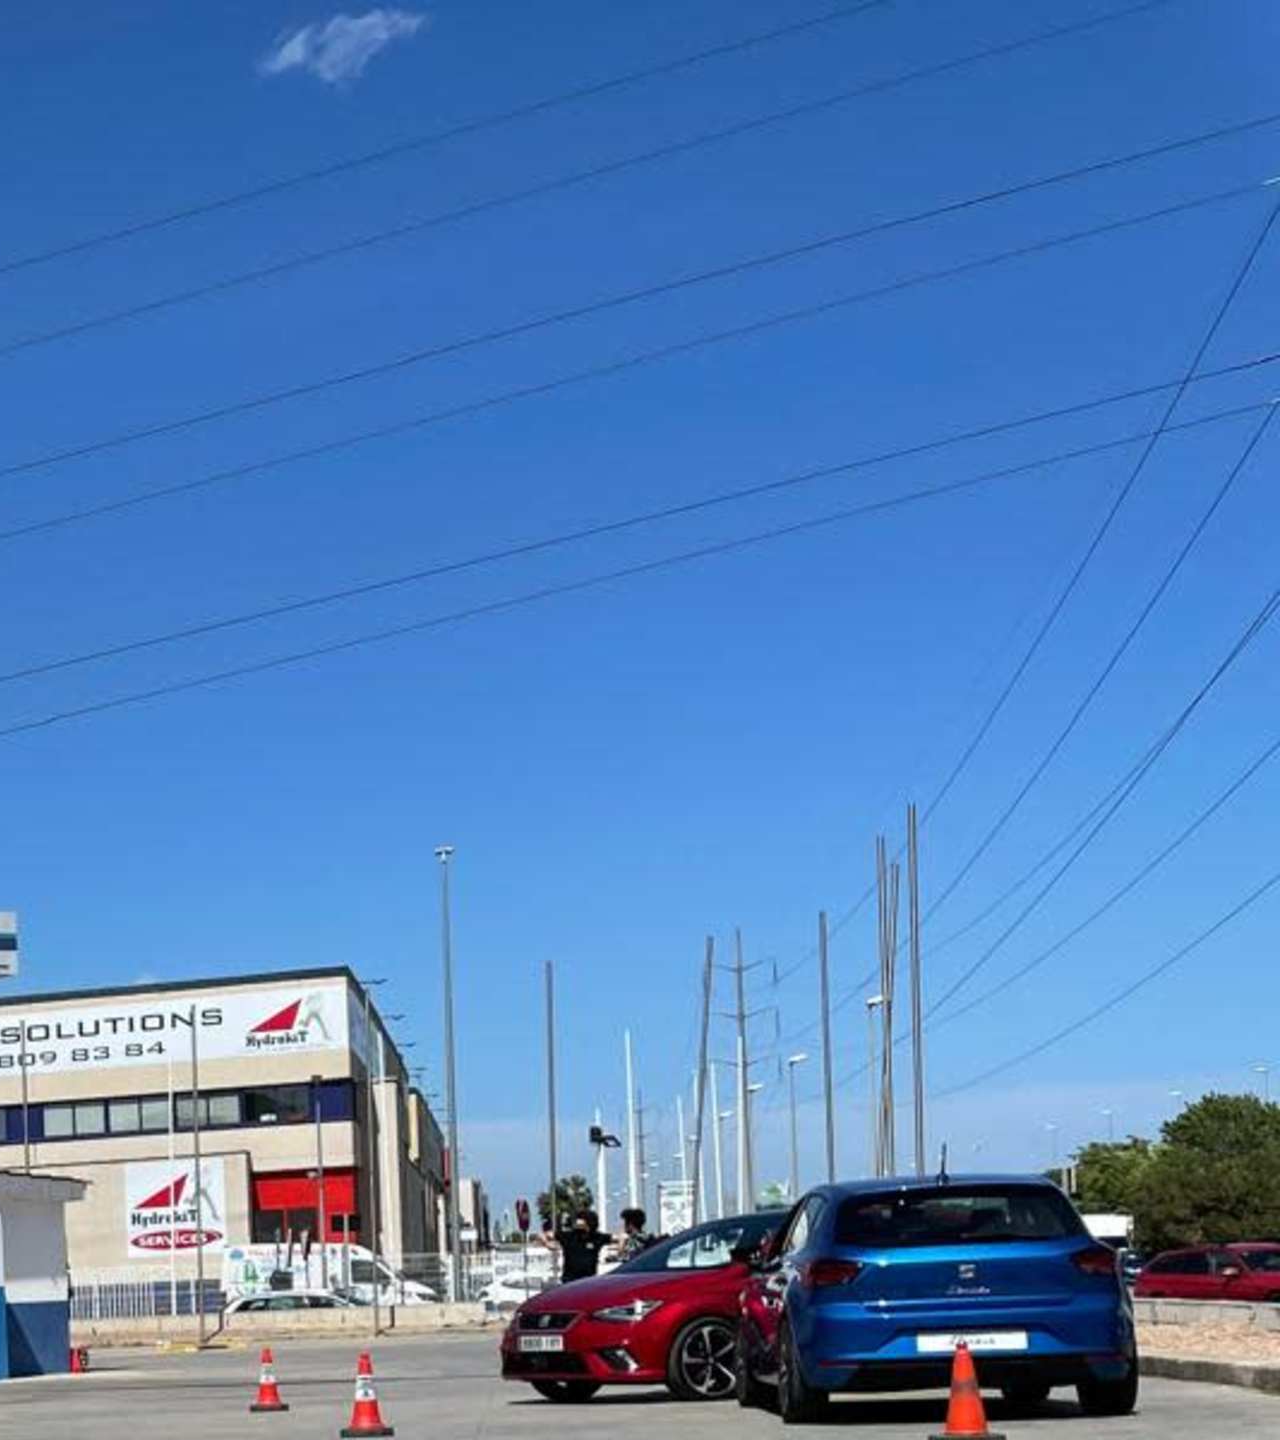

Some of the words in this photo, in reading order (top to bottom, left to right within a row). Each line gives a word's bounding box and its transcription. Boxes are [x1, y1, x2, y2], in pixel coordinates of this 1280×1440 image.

[0, 1007, 224, 1045] SOLUTIONS
[72, 1045, 110, 1062] 83
[125, 1040, 166, 1058] 84
